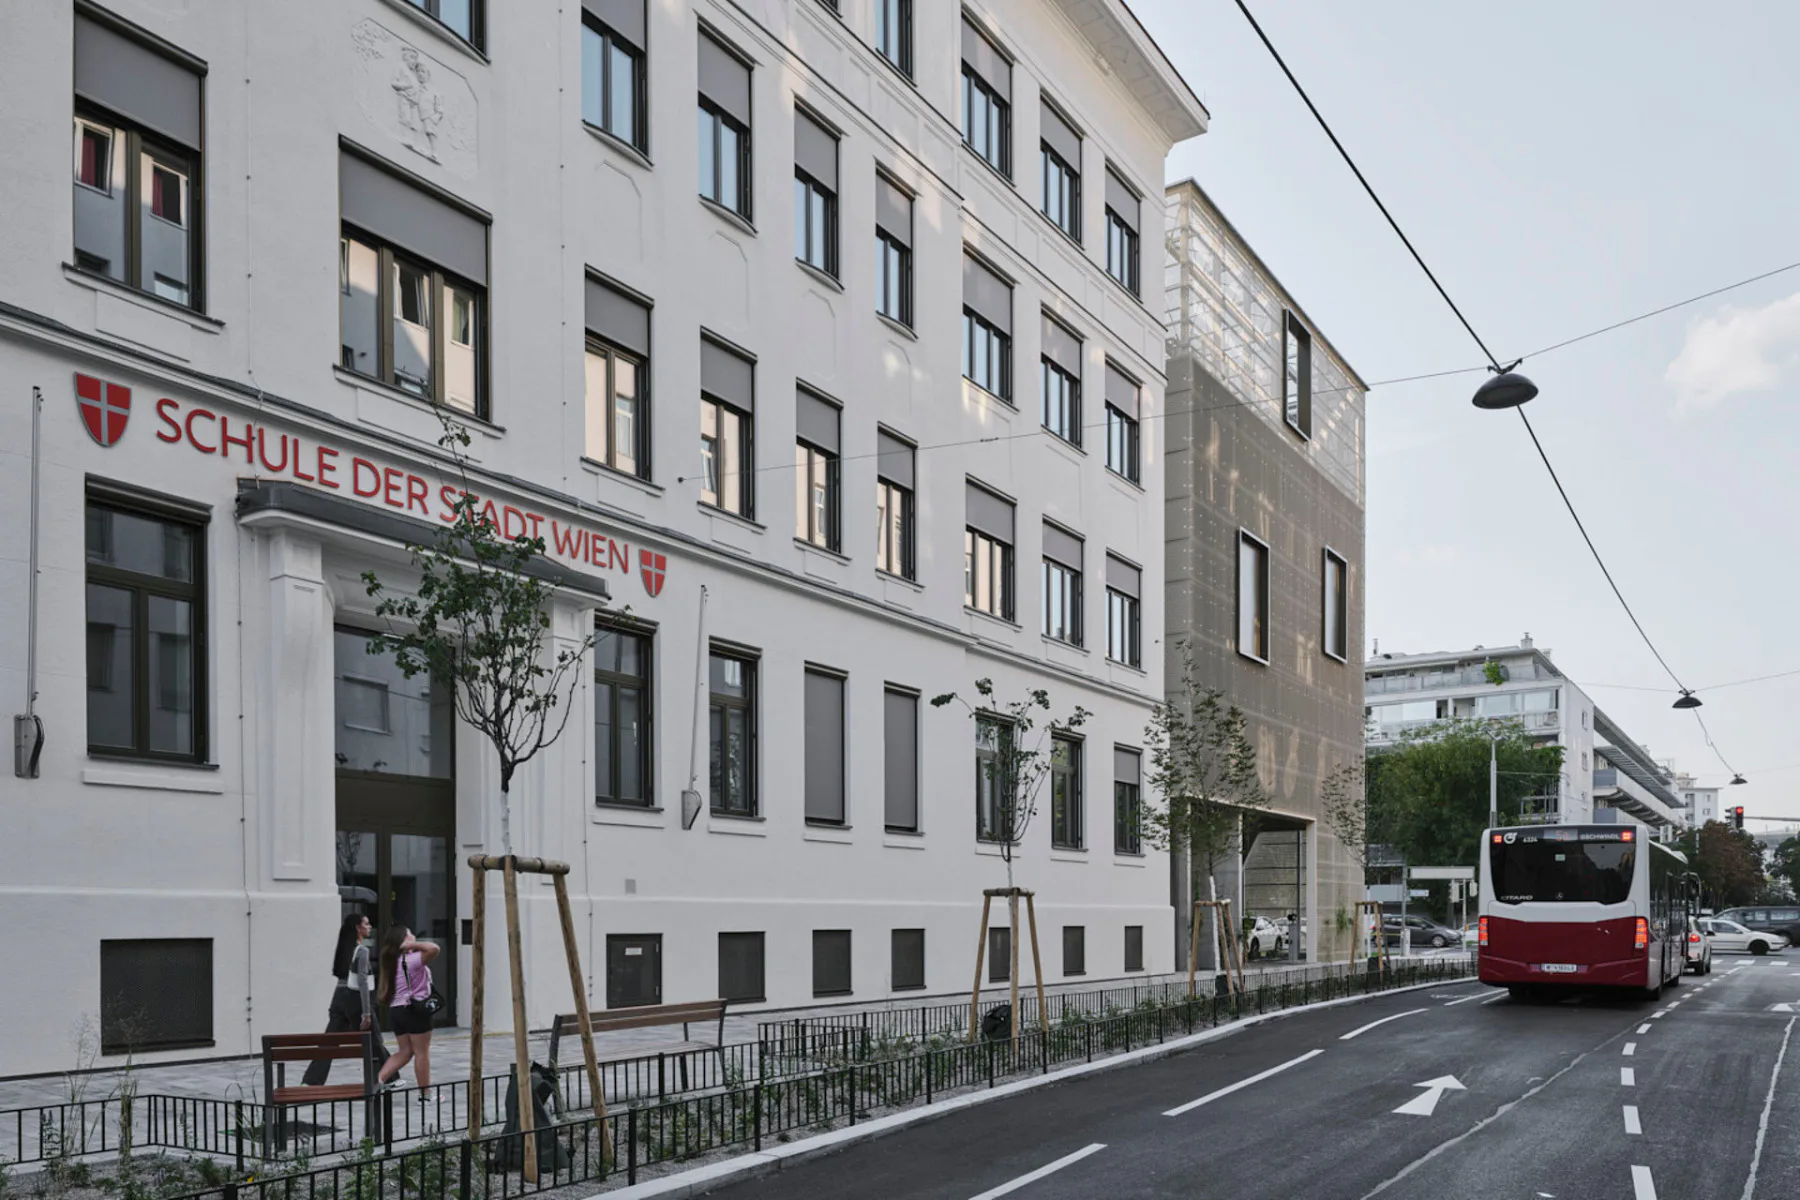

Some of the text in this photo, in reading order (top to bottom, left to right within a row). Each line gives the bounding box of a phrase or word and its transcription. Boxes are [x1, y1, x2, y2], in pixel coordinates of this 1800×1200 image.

[155, 397, 630, 575] SCHULE DER STADT WIEN
